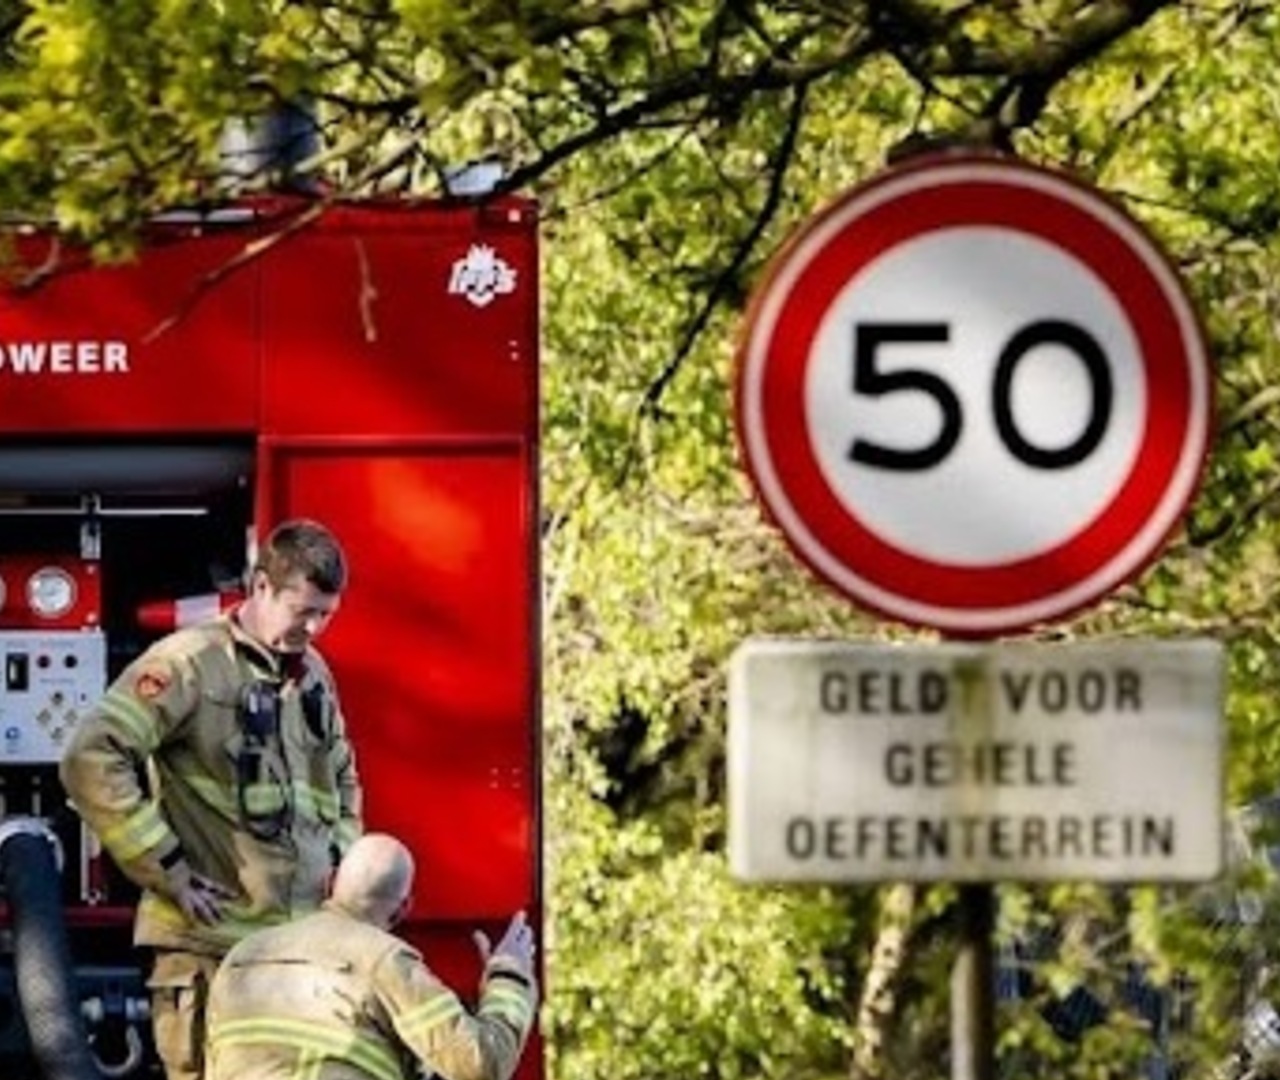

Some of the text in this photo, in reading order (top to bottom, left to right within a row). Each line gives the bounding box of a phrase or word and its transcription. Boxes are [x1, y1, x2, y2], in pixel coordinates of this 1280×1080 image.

[847, 318, 1115, 472] 50
[820, 669, 1142, 714] GELDT VOOR
[884, 742, 1077, 787] GEHELE
[785, 816, 1175, 861] OEFENTERREIN
